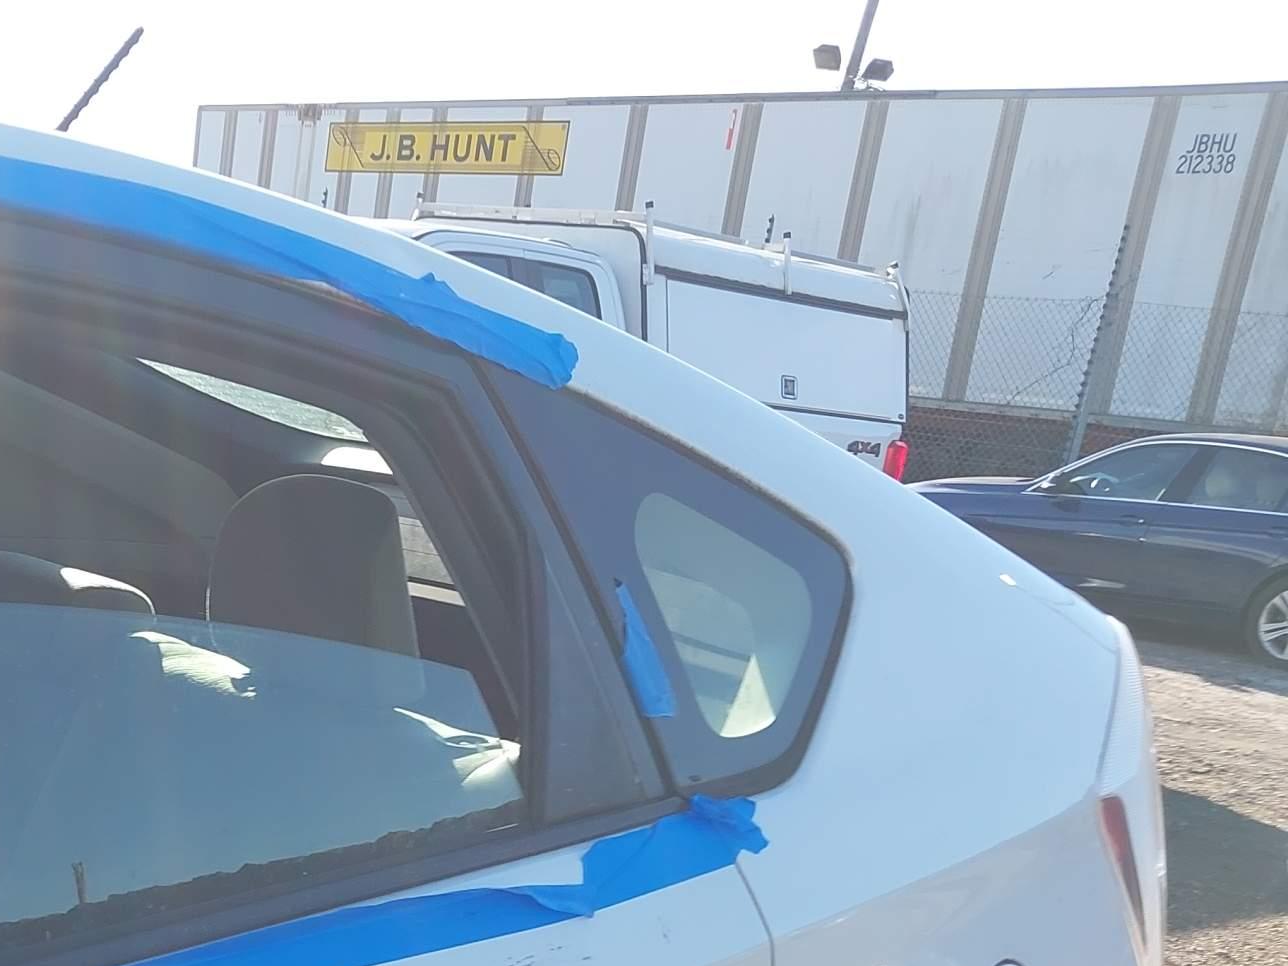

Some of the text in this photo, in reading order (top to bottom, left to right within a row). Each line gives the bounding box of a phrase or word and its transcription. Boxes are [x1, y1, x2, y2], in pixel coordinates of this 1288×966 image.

[429, 133, 517, 163] HUNT
[1185, 132, 1239, 154] JBHU
[1175, 153, 1237, 175] 212338
